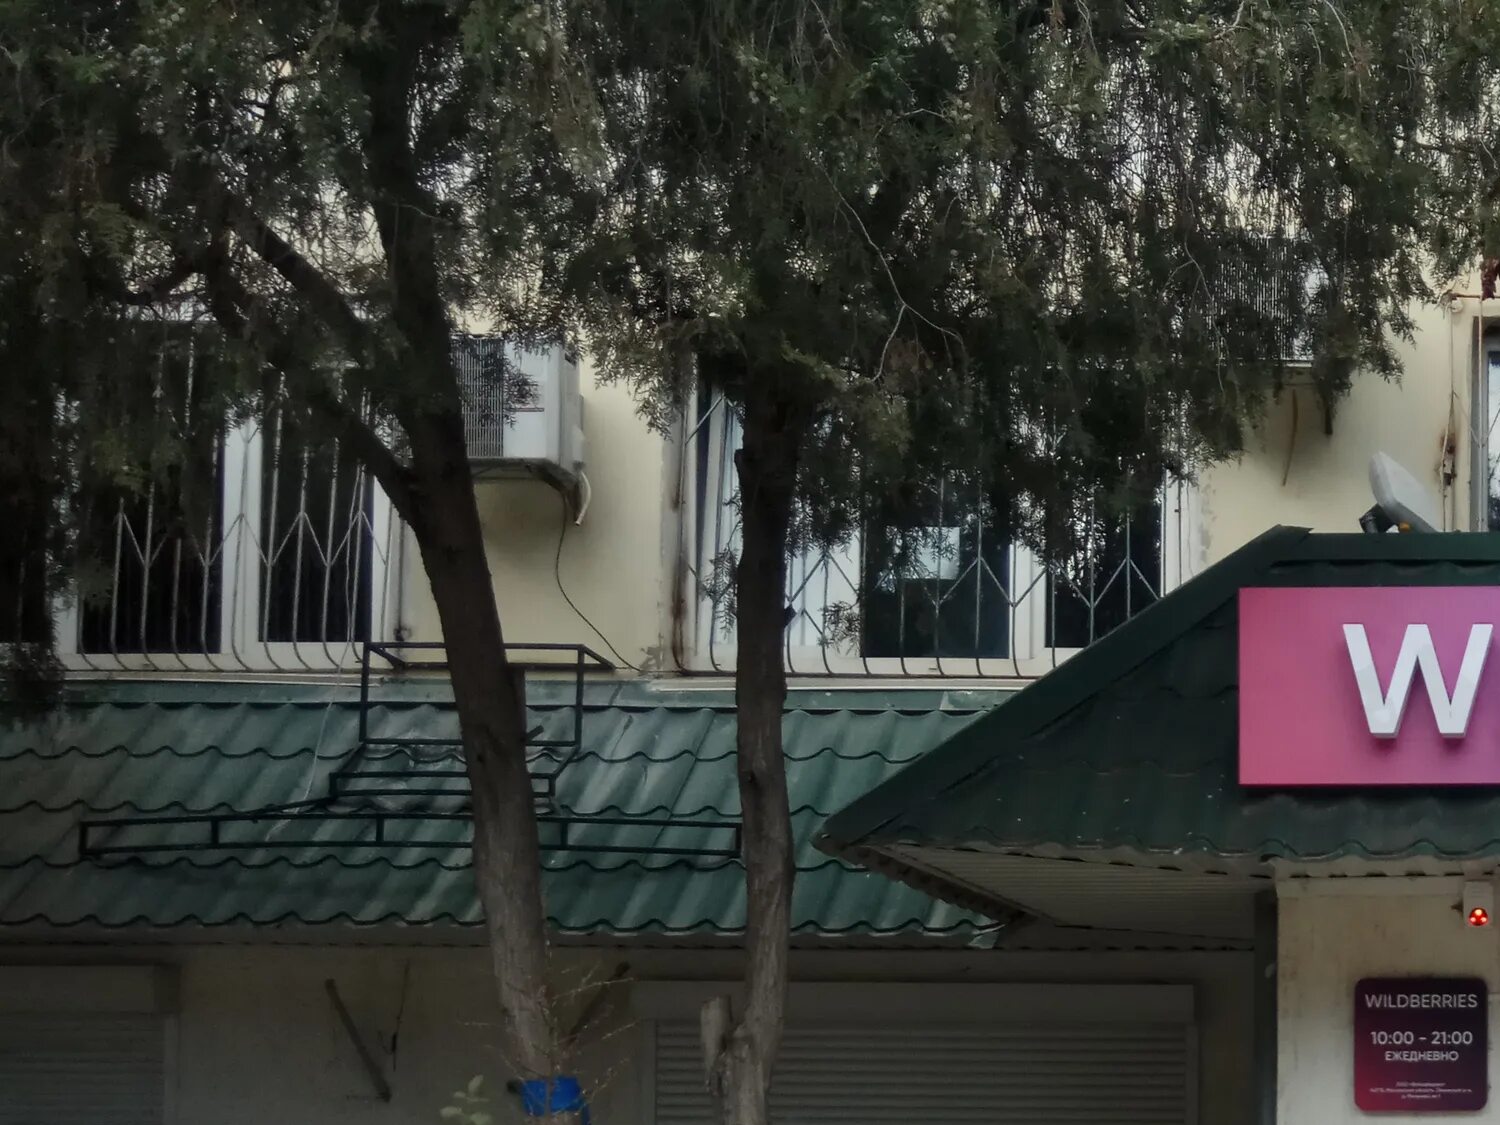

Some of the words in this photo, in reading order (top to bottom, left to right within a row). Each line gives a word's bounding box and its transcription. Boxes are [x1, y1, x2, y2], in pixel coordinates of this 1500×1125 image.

[1364, 993, 1478, 1009] WILDBERRIES
[1370, 1031, 1415, 1045] 10:00
[1431, 1031, 1473, 1045] 21:00
[1384, 1050, 1460, 1063] ЕЖЕДНЕВНО
